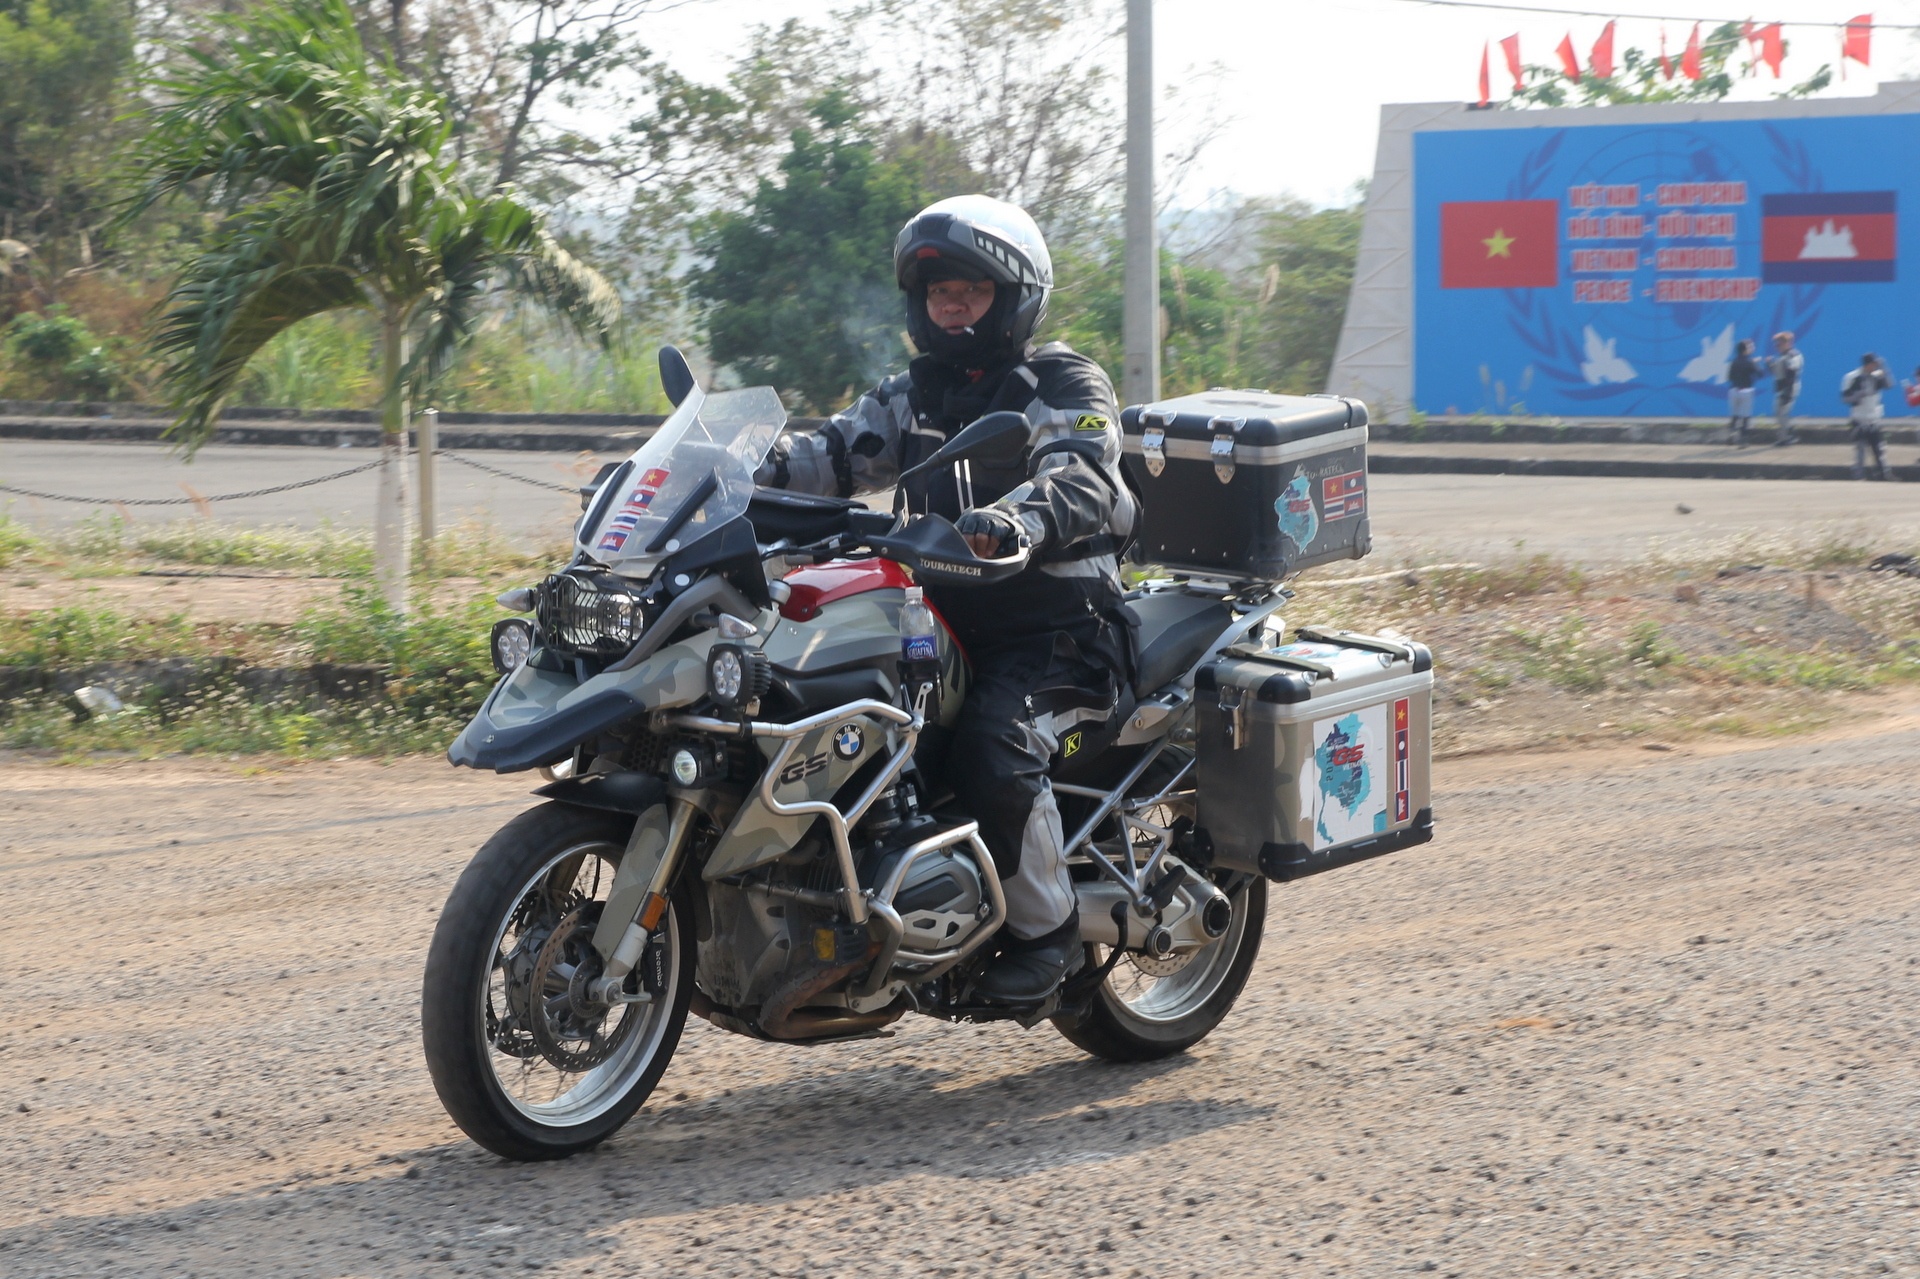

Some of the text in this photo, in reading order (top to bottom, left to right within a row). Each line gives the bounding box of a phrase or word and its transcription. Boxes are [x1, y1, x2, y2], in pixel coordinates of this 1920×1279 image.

[1655, 246, 1736, 271] CAMBODIA
[1573, 279, 1632, 303] PEACE
[1655, 277, 1761, 302] FRIENDSHIP
[919, 558, 982, 577] TOURATECH
[835, 725, 861, 741] BMW
[1332, 744, 1365, 766] GS
[780, 752, 827, 785] GS
